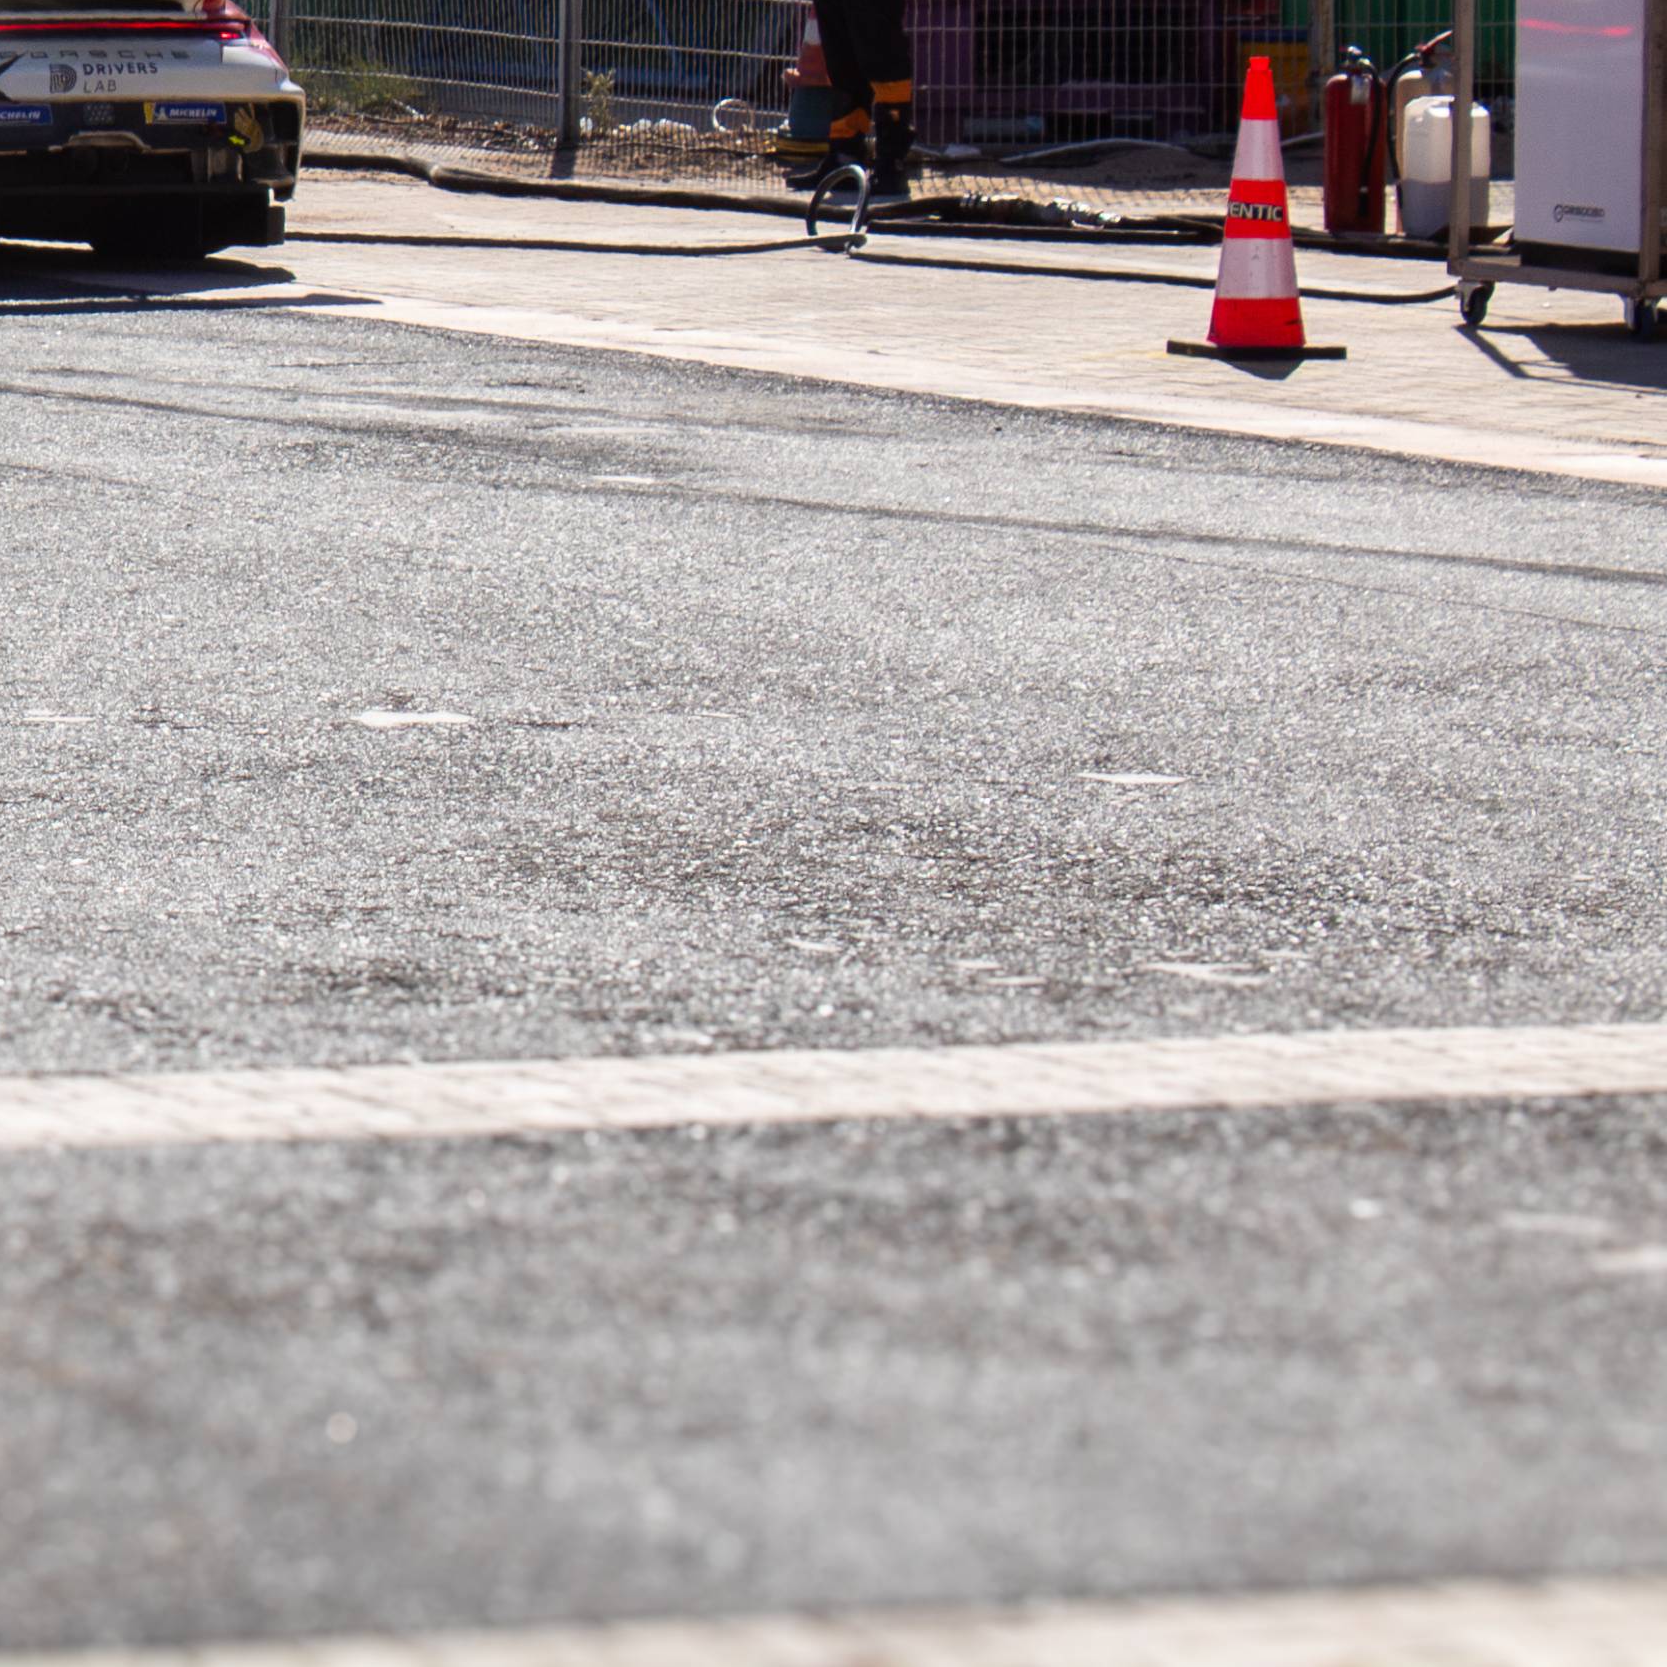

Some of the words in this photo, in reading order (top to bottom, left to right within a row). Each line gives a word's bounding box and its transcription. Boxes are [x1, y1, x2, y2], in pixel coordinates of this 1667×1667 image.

[82, 61, 159, 75] DRIVERS
[82, 80, 117, 94] LAB
[169, 107, 218, 117] MICHELIN
[1228, 201, 1283, 222] ENTIC
